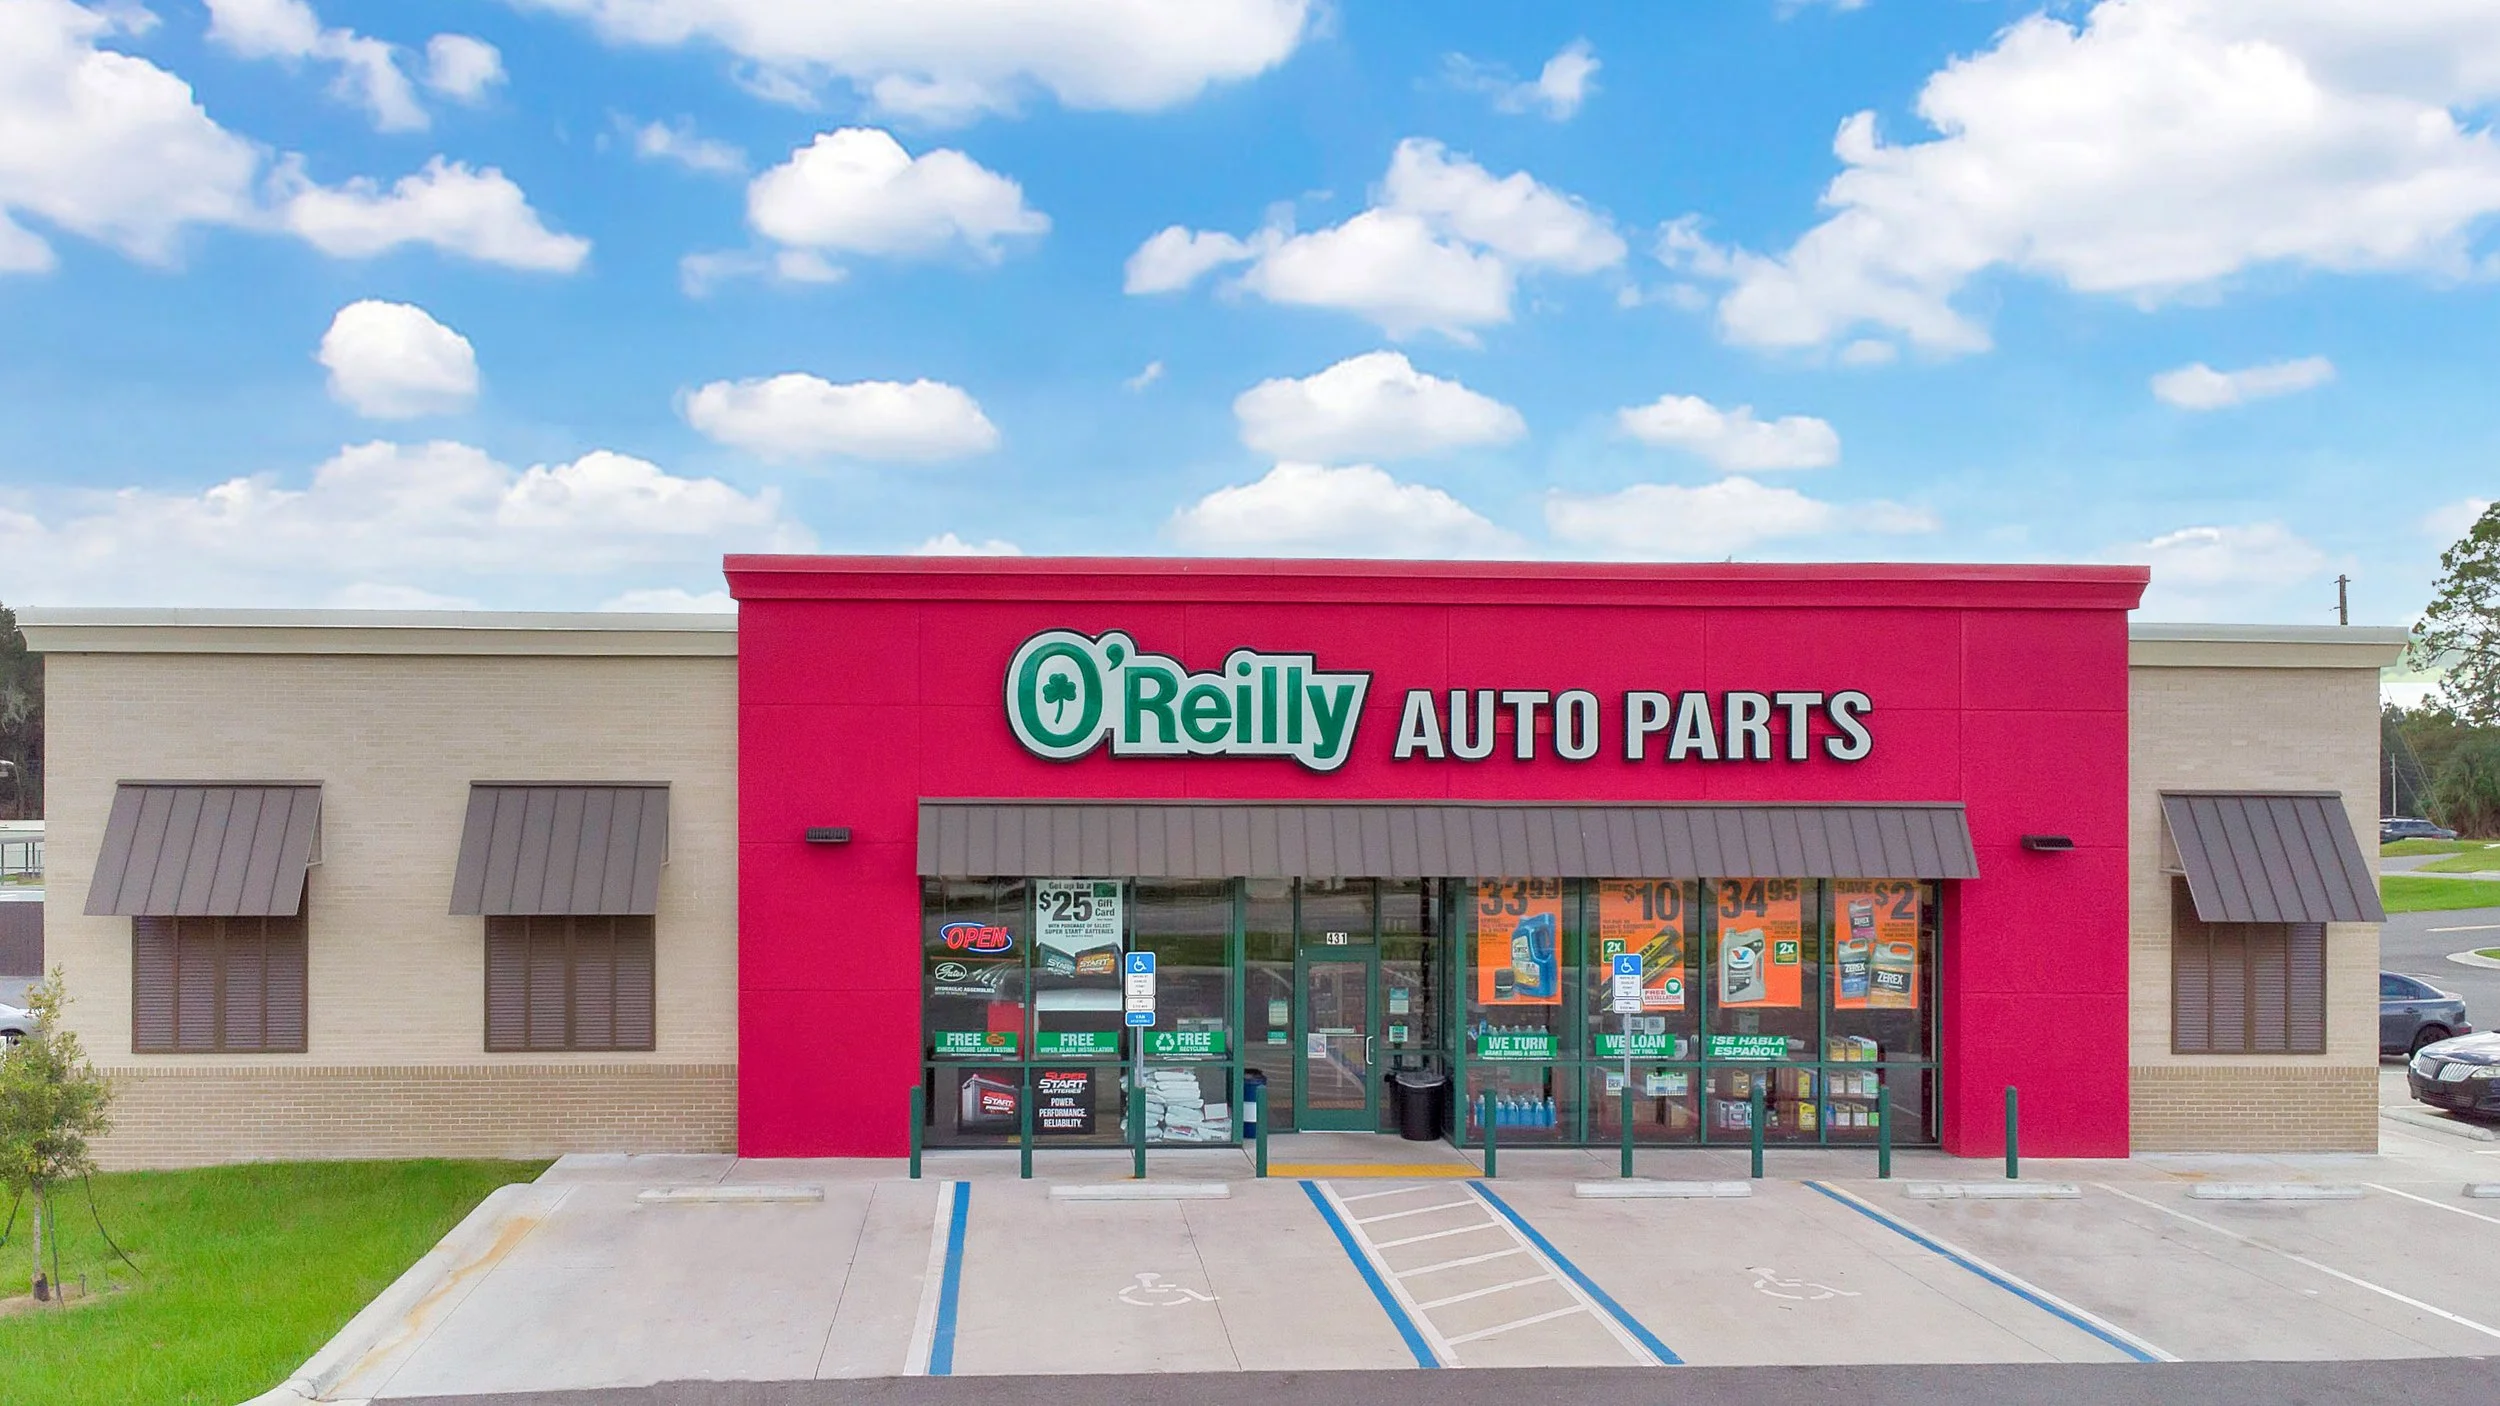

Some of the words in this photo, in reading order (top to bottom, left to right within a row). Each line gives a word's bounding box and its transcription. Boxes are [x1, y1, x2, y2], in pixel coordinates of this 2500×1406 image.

[1018, 642, 1356, 759] O'Reilly
[1395, 689, 1599, 761] AUTO
[1626, 690, 1874, 761] PARTS
[1076, 882, 1085, 890] to
[1039, 890, 1093, 922] $25
[1097, 899, 1113, 908] Gift
[1875, 882, 1915, 920] $2
[1095, 908, 1115, 917] Card
[947, 926, 1008, 950] OPEN
[1327, 932, 1346, 944] 431
[938, 965, 964, 980] Gates
[1844, 963, 1866, 973] ZEREX
[1877, 971, 1904, 986] ZEREX
[946, 1033, 982, 1046] FREE
[1060, 1033, 1095, 1046] FREE
[1177, 1032, 1211, 1046] FREE
[1488, 1037, 1510, 1050] WE
[1513, 1037, 1548, 1050] TURN
[1605, 1035, 1625, 1048] WE
[1631, 1035, 1666, 1048] LOAN
[1738, 1037, 1785, 1046] HABLA
[1714, 1045, 1783, 1057] ESPAÑOL!
[1045, 1072, 1087, 1080] SUPER
[1038, 1079, 1088, 1089] START
[983, 1096, 1014, 1106] START
[1051, 1097, 1076, 1107] POWER.
[1039, 1108, 1087, 1117] PERFORMANCE.
[1044, 1118, 1083, 1128] RELIABILITY.
